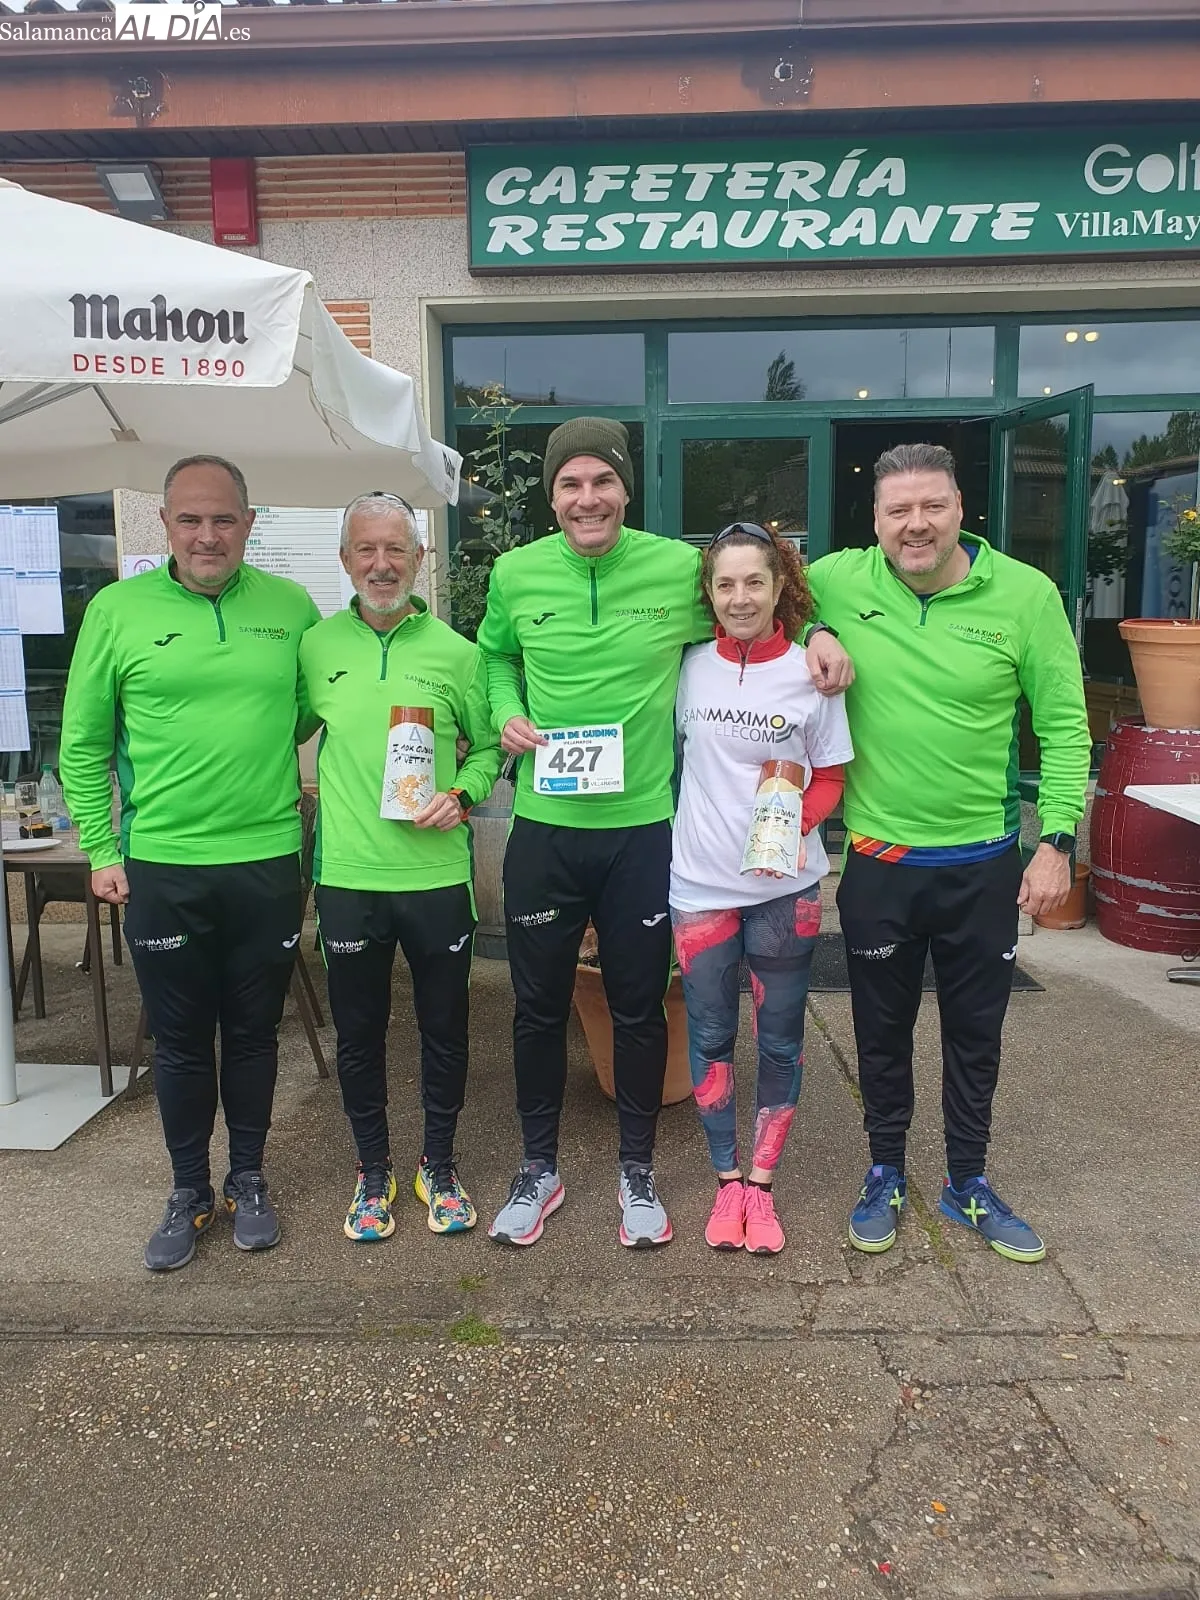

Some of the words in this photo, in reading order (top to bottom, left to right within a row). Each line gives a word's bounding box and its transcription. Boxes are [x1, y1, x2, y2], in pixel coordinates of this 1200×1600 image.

[486, 149, 905, 206] CAFETERÍA
[486, 202, 1041, 256] RESTAURANTE
[69, 292, 249, 345] Mahou
[73, 353, 164, 376] DESDE
[181, 357, 245, 378] 1890
[684, 707, 786, 730] SANMAXIMO
[713, 723, 776, 744] ELECOM
[548, 746, 603, 774] 427
[134, 934, 183, 947] SANMAXIMO
